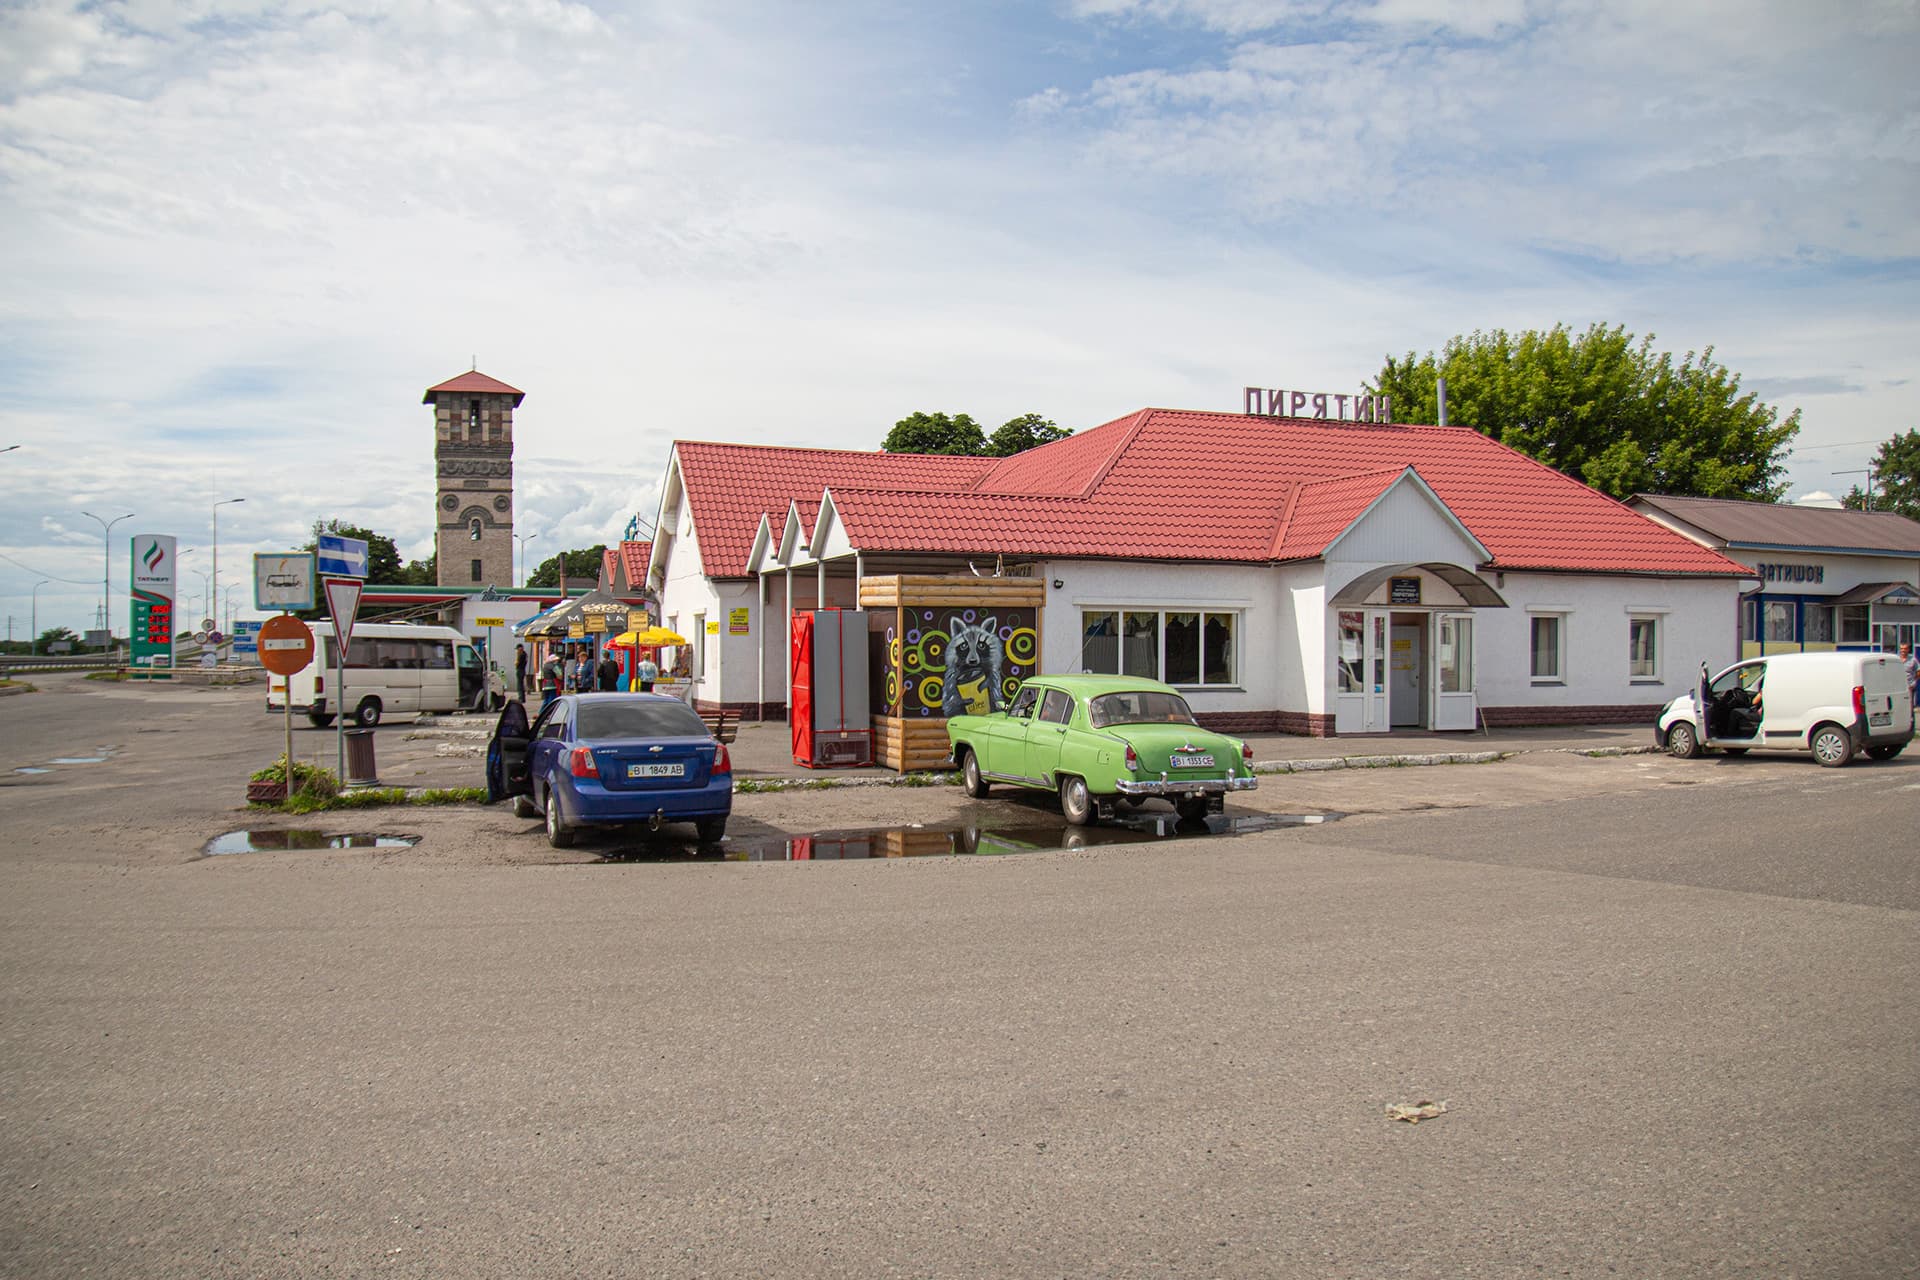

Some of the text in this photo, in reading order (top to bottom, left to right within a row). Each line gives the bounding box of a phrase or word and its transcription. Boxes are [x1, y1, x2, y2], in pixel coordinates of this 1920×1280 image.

[1245, 387, 1391, 423] ПИРЯТИН
[1758, 563, 1824, 584] ЗАТИШОК
[1187, 757, 1202, 765] 1353
[633, 765, 683, 775] BI 1849 AB
